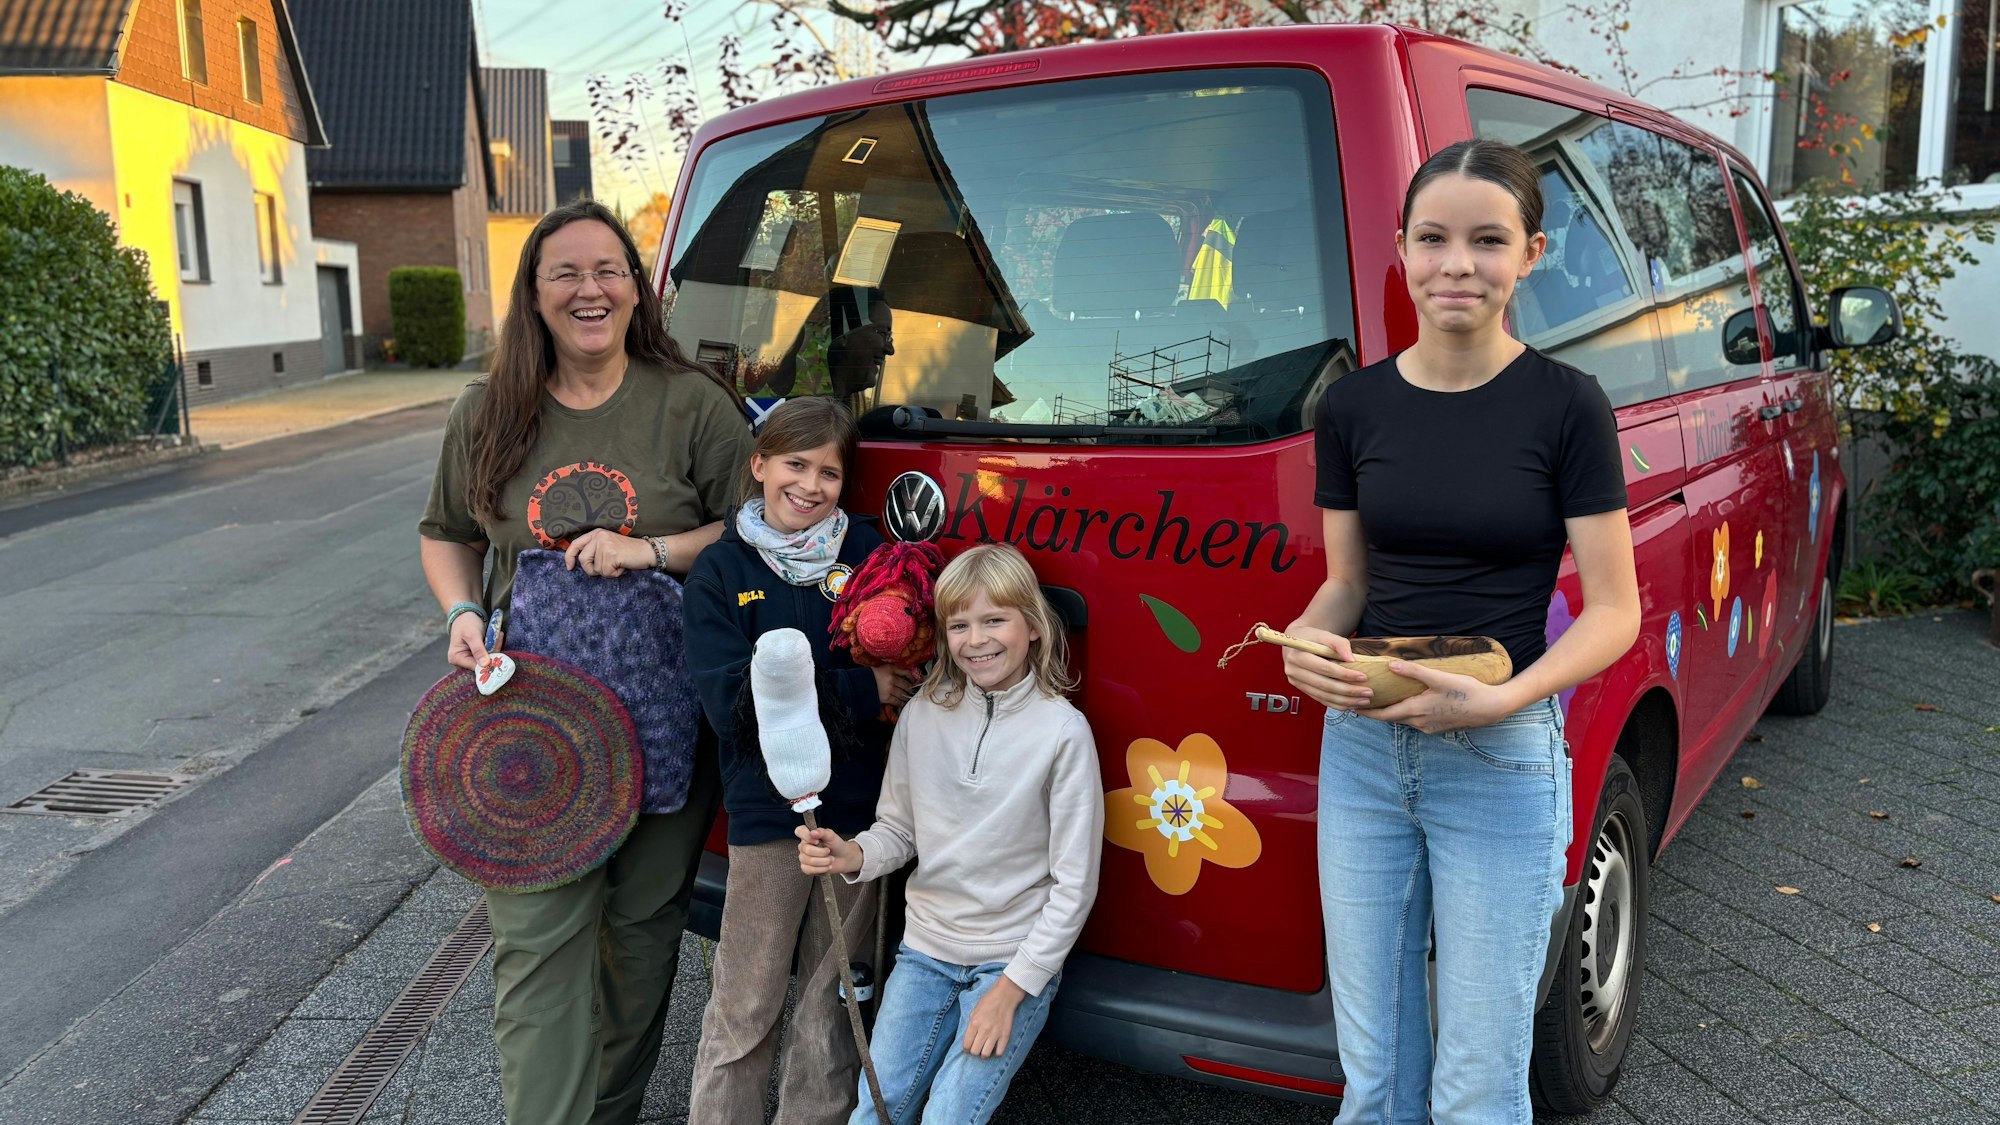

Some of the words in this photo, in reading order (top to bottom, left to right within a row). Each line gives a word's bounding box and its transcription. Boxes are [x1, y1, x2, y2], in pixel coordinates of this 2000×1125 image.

[1692, 402, 1748, 465] Klärch
[887, 473, 943, 543] VW
[943, 472, 1297, 573] Klärchen
[1245, 691, 1300, 714] TDI
